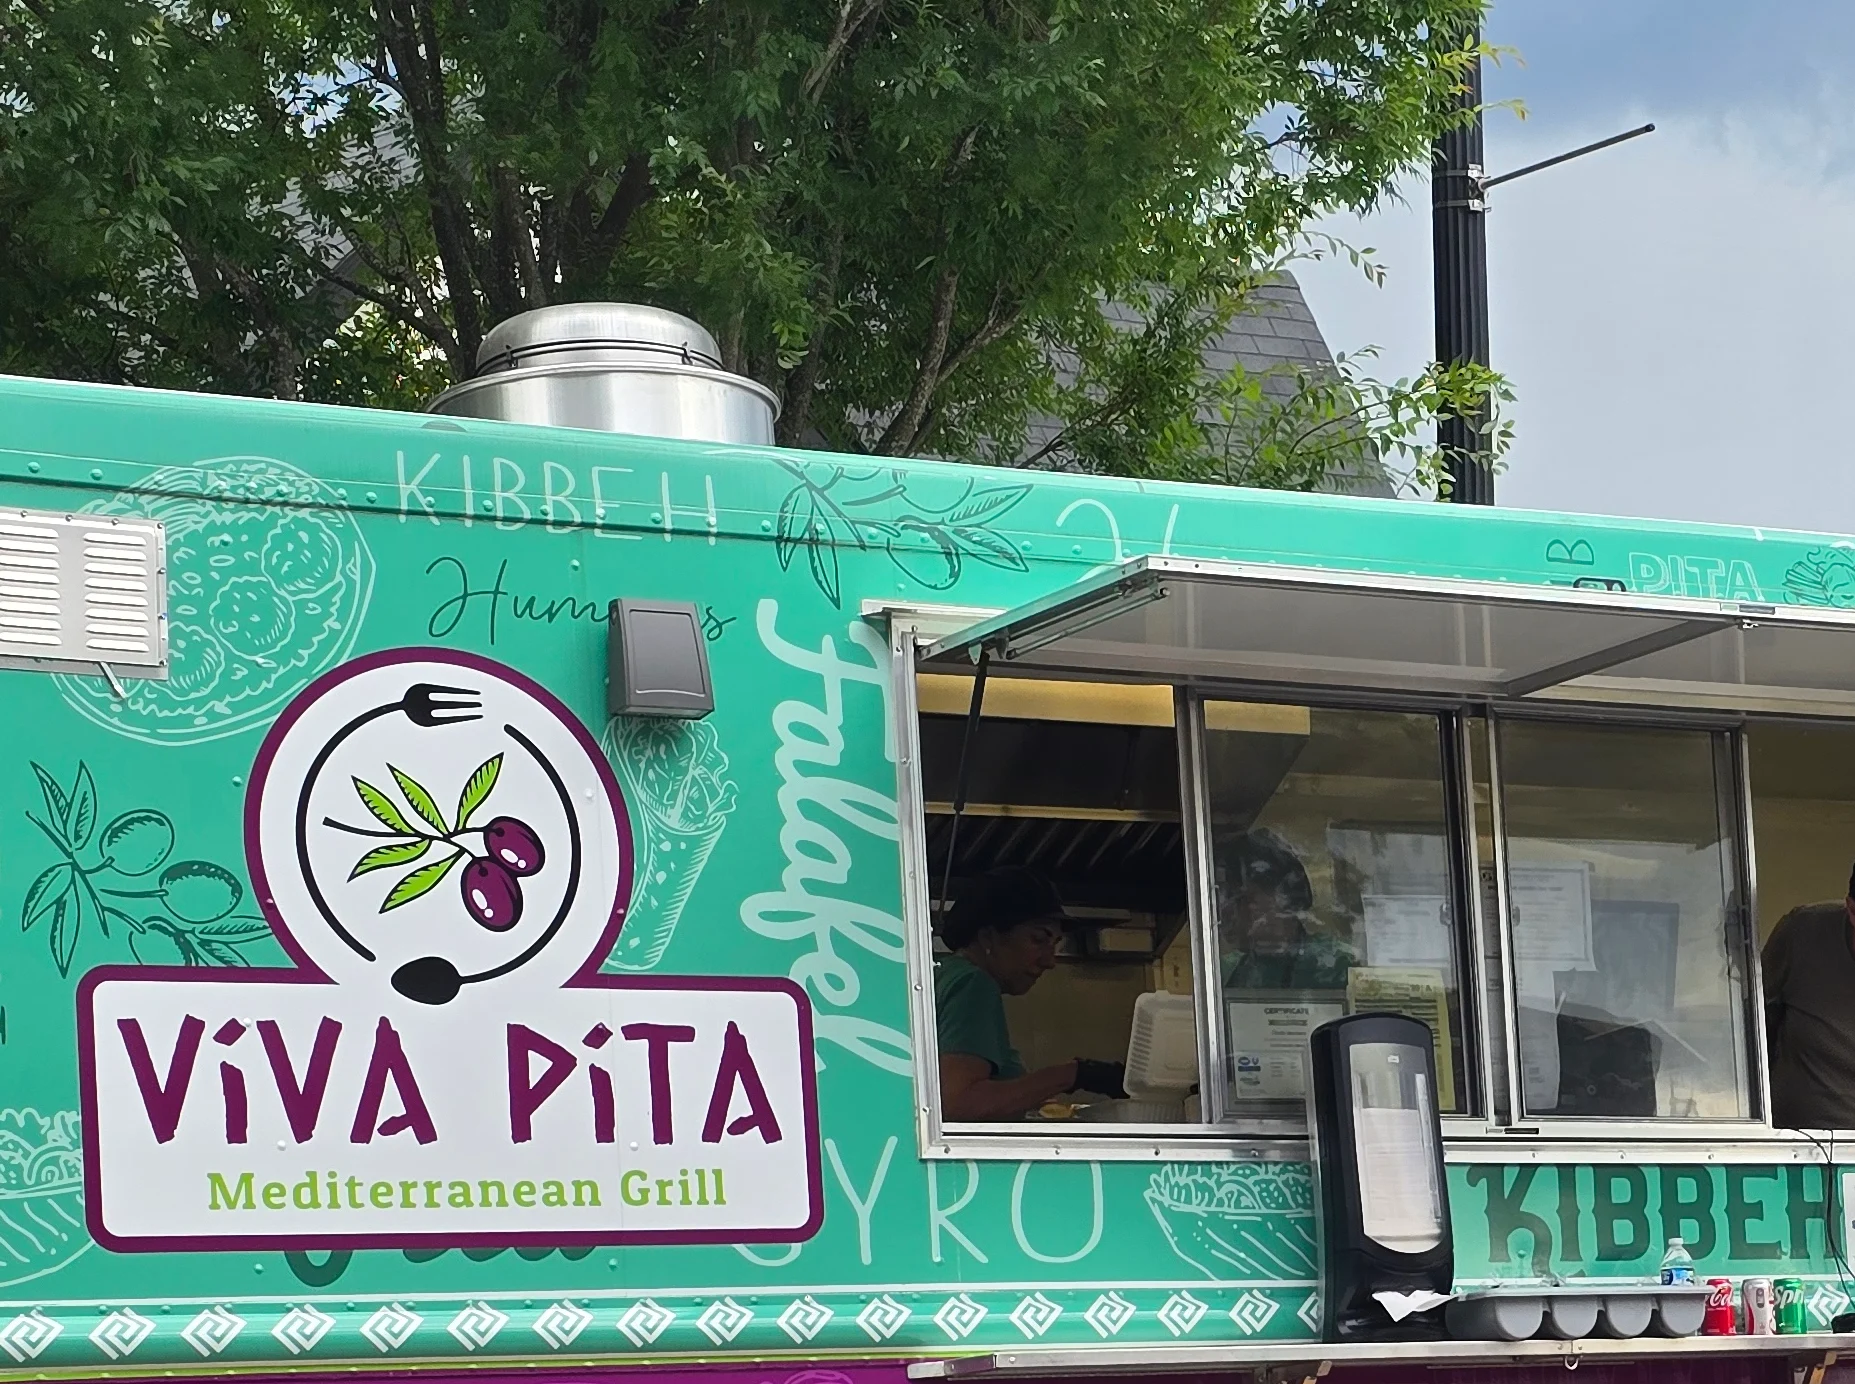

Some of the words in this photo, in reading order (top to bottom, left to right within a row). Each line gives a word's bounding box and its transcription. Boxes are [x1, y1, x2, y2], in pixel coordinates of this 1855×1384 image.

[397, 450, 718, 546] KIBBEH
[425, 556, 738, 645] Hums
[1627, 550, 1766, 605] PITA
[740, 598, 914, 1078] Falafel
[206, 1172, 604, 1212] Mediterranean
[619, 1168, 728, 1208] Grill
[732, 1135, 1105, 1268] YRO
[1466, 1162, 1846, 1278] KIBBEH
